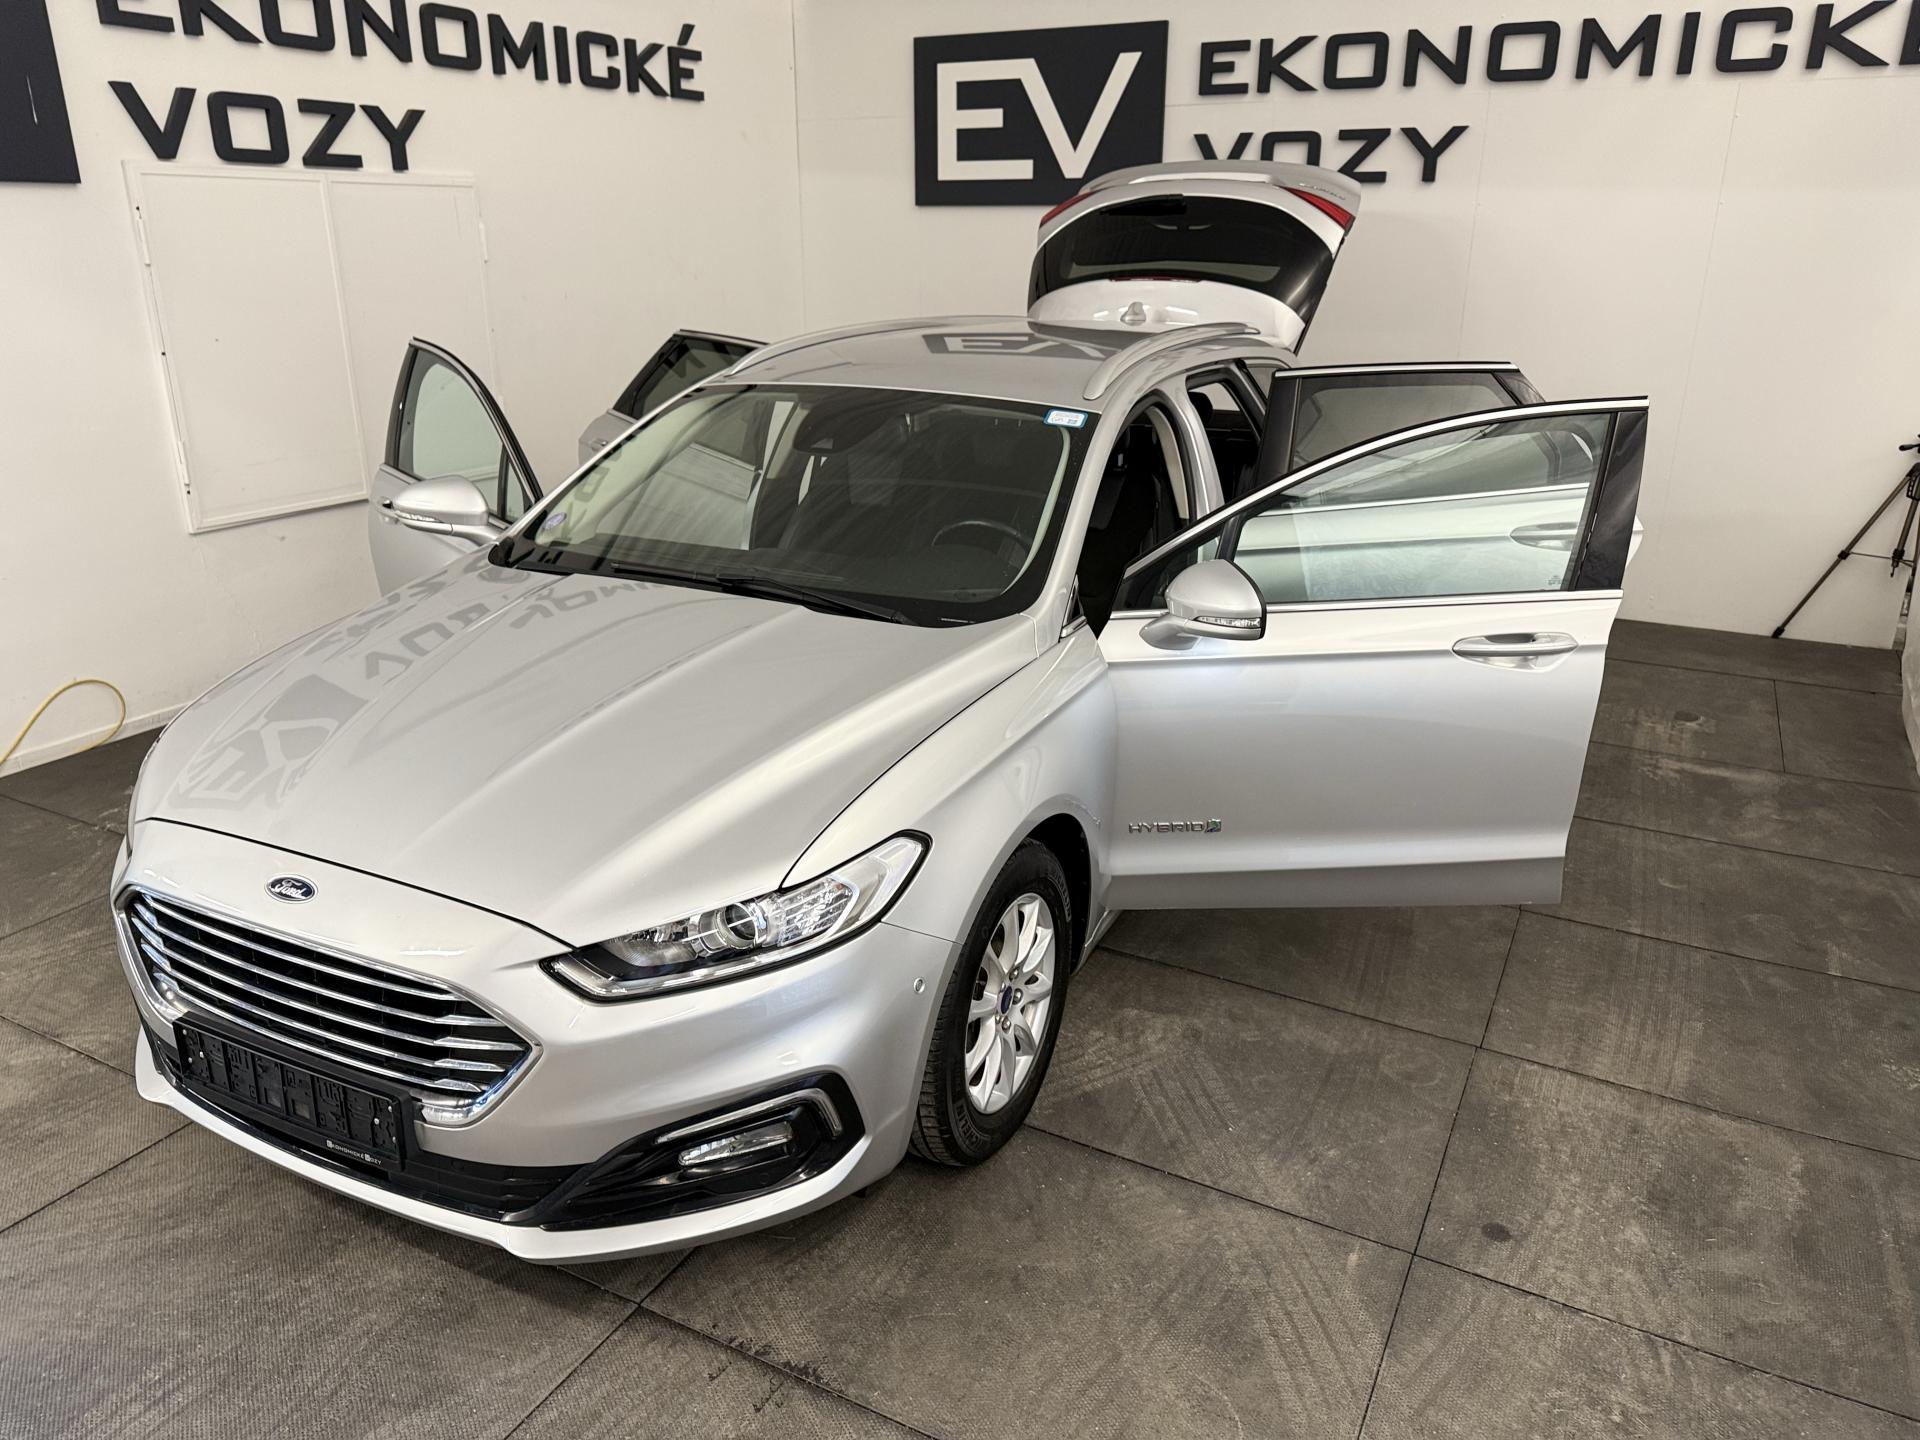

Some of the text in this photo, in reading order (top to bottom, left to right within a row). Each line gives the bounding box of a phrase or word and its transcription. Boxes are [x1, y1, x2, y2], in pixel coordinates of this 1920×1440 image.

[1199, 0, 1920, 96] EKONOMICK
[108, 81, 424, 171] VOZY
[937, 52, 1142, 181] EV
[1128, 821, 1204, 833] HYBRID
[269, 878, 307, 900] Ford
